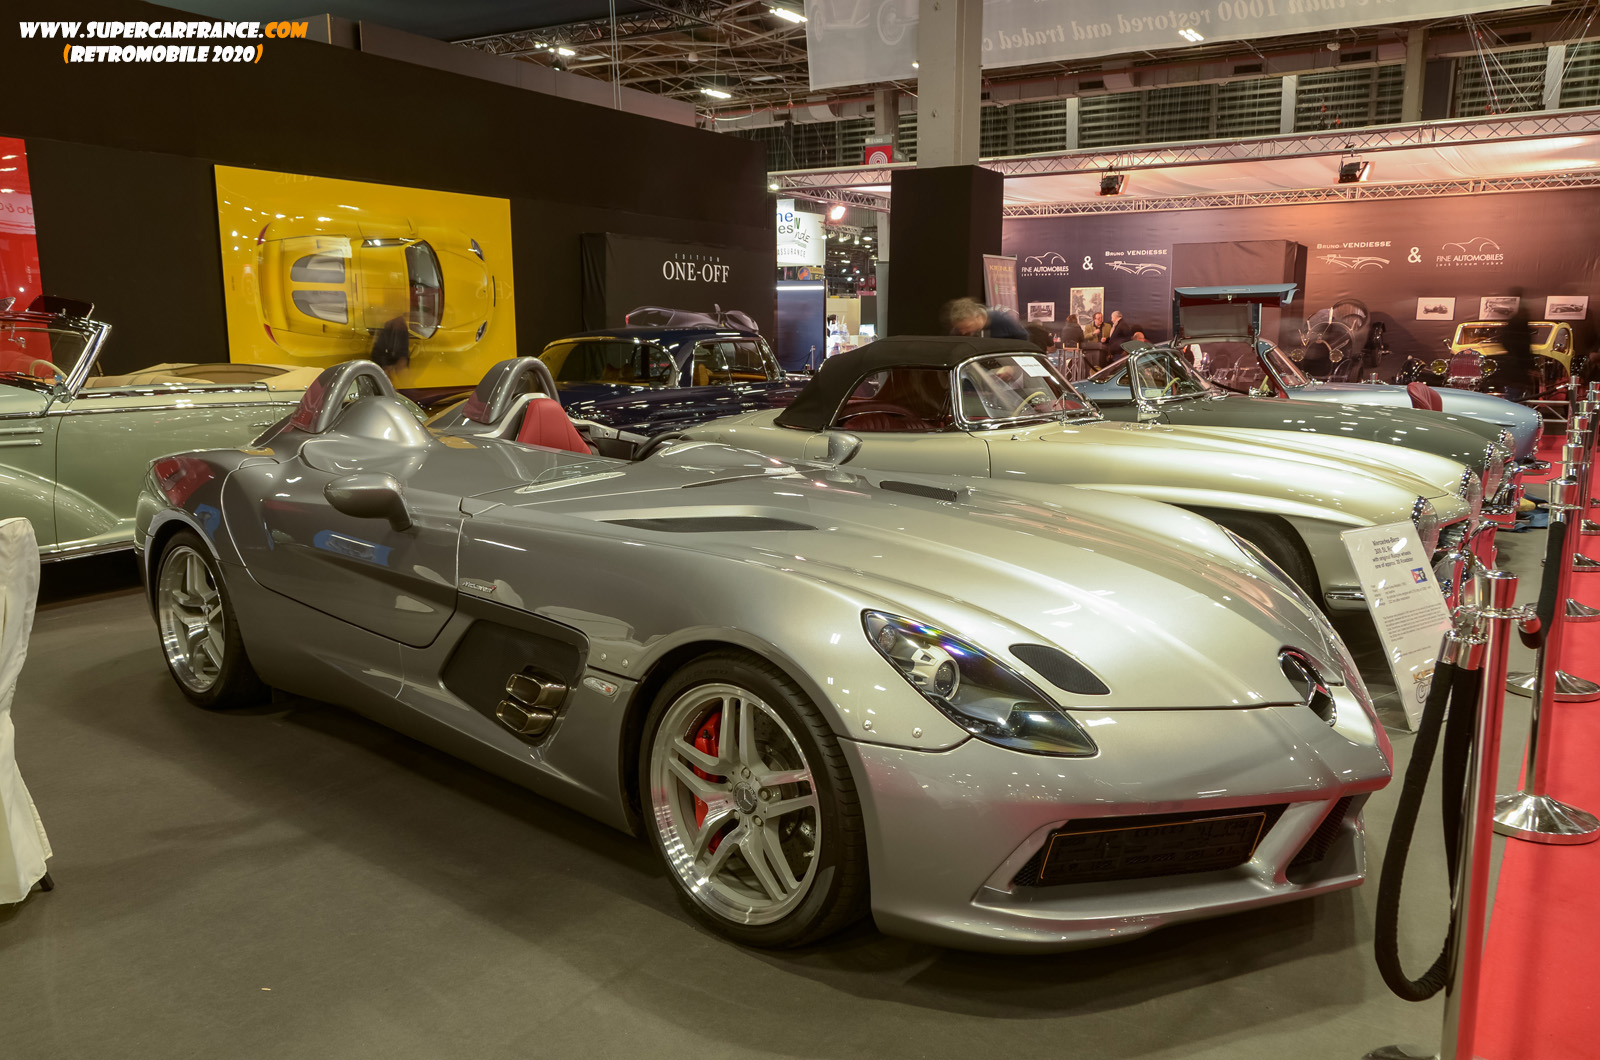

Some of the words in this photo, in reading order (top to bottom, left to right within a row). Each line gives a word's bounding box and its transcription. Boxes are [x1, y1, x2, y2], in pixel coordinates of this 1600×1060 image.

[1342, 240, 1392, 248] VENDIESSE
[1407, 246, 1422, 263] &
[1452, 253, 1504, 262] AUTOMOBILES
[1082, 255, 1094, 271] &
[662, 260, 730, 283] ONE-OFF
